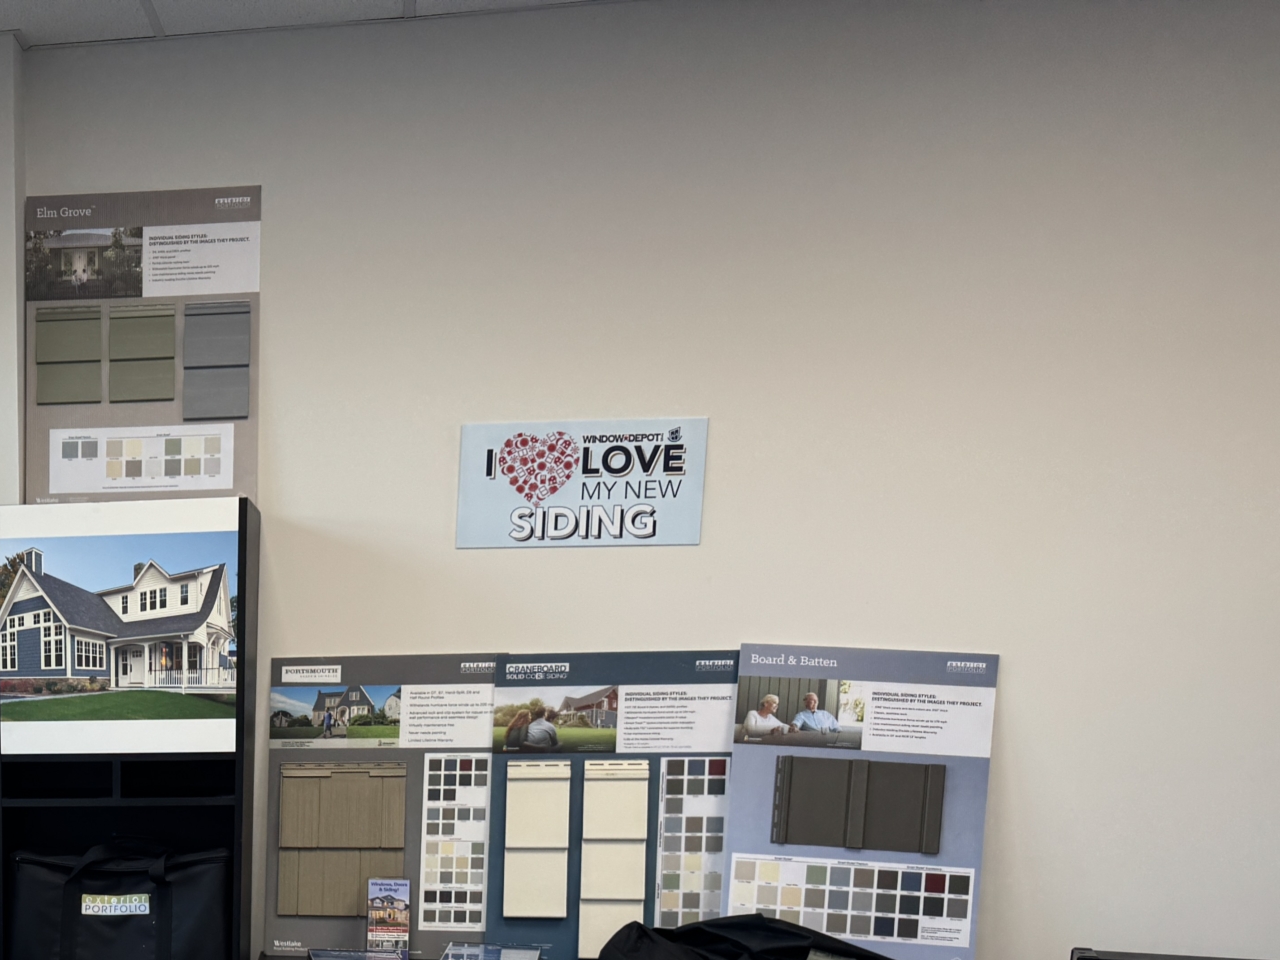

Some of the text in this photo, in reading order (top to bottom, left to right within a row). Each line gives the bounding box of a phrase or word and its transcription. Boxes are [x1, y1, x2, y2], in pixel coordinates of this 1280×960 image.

[36, 207, 92, 218] Elm Grove
[486, 445, 686, 479] I LOVE
[581, 480, 682, 500] MY NEW
[509, 504, 656, 541] SIDING
[751, 654, 838, 667] Board & Batten
[508, 665, 567, 673] CRANEBOARD
[86, 895, 146, 905] exterior
[85, 904, 147, 914] PORTFOLIO
